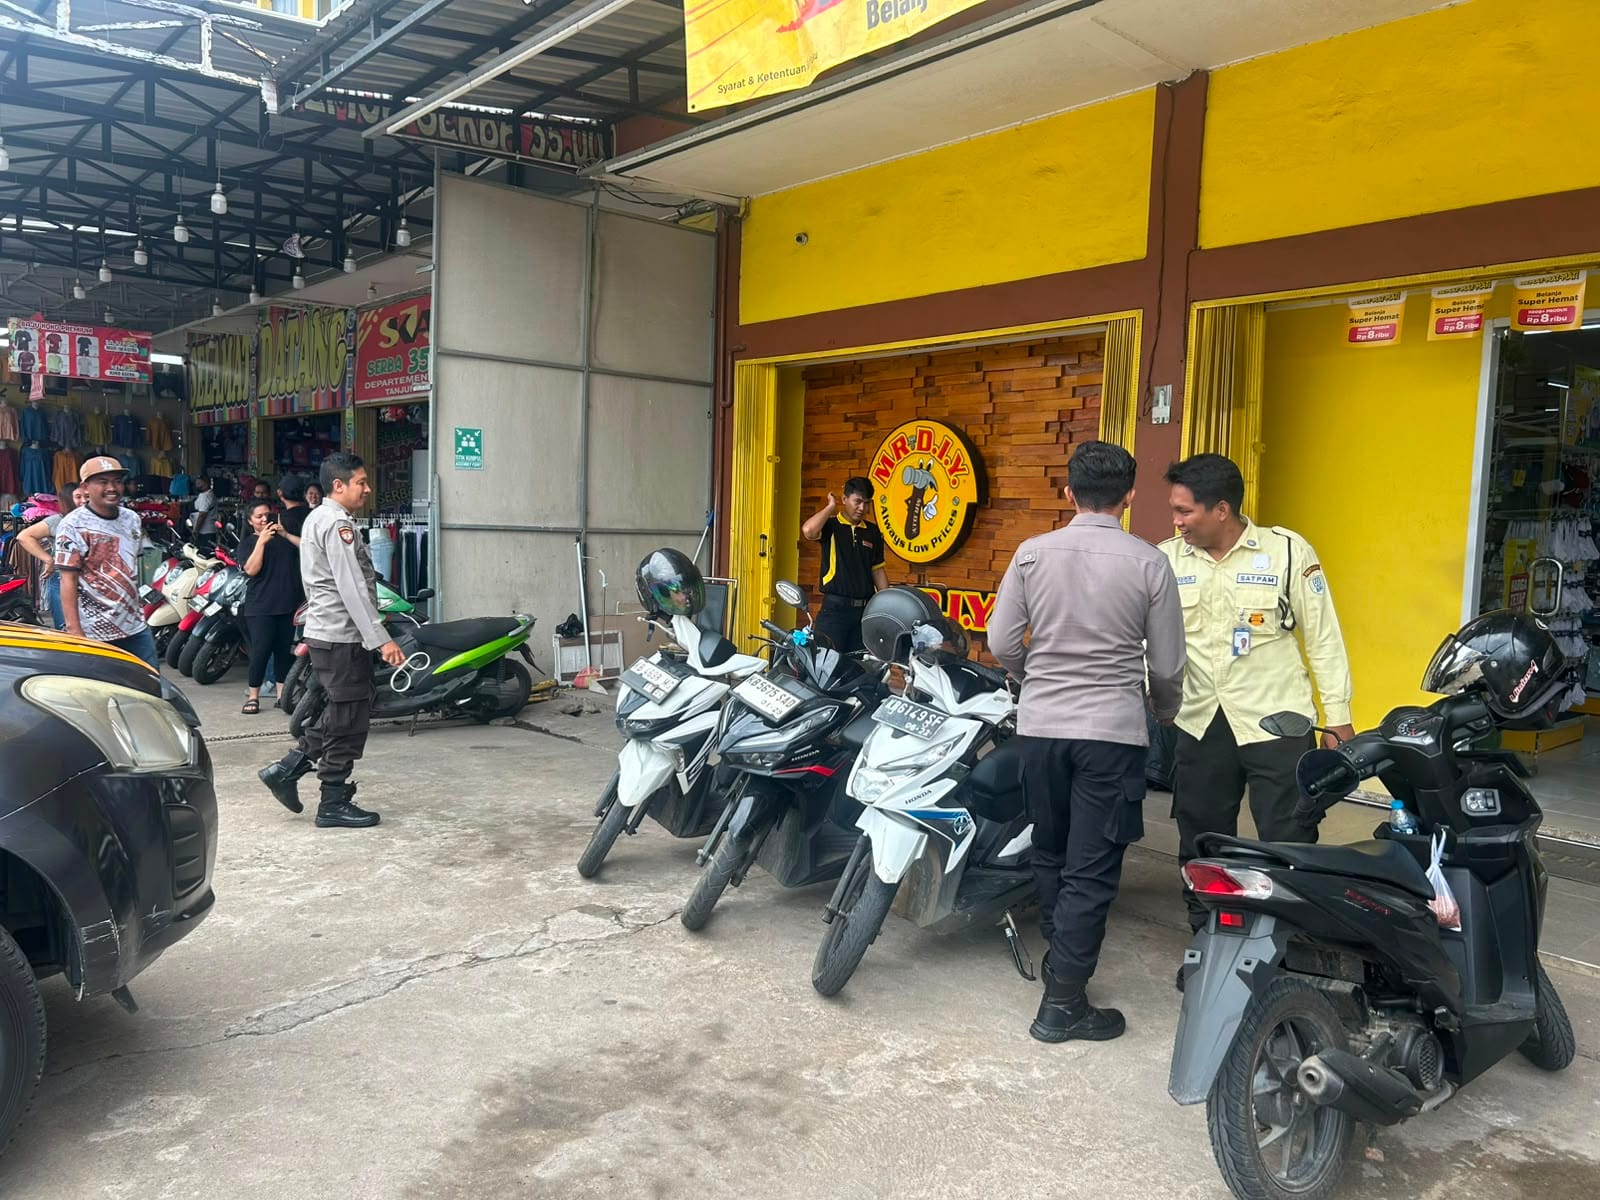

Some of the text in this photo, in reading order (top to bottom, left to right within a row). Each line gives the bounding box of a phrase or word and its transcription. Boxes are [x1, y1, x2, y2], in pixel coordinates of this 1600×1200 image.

[717, 64, 807, 95] Syarat & Ketentuan
[1518, 294, 1578, 306] Super Hemat
[1349, 313, 1400, 324] Super Hemat
[1455, 321, 1464, 330] 8
[1540, 313, 1549, 322] 8
[21, 320, 94, 335] BAJU KOKO PREMIUM
[1367, 330, 1375, 339] 8
[258, 307, 347, 400] DATANG
[367, 354, 403, 377] SERBA
[881, 505, 958, 553] Always Low Prices
[1239, 575, 1275, 583] SATPAM
[757, 679, 777, 698] 5675
[896, 702, 928, 723] 6149
[926, 715, 945, 727] SF
[905, 789, 932, 806] HONDA
